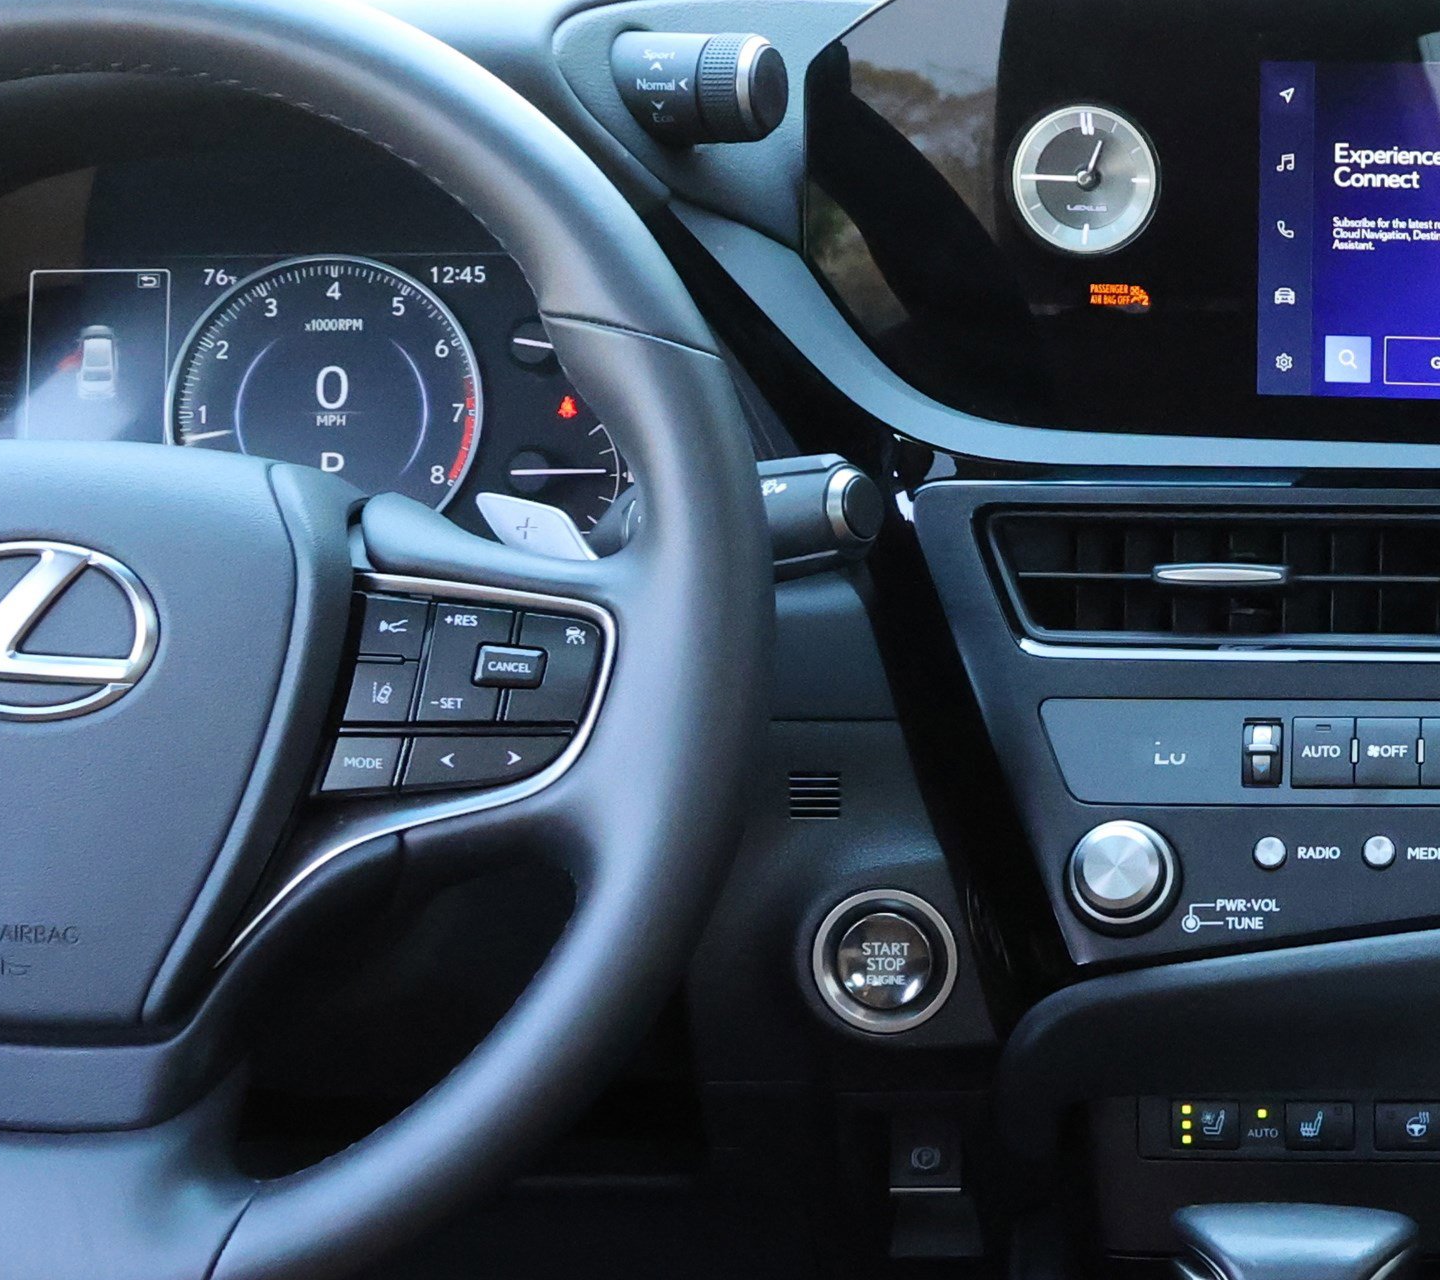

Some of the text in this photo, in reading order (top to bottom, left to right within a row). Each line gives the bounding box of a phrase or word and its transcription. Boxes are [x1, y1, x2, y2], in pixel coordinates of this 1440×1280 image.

[643, 49, 676, 61] Sport
[636, 78, 676, 91] Normal
[1333, 167, 1420, 189] Connect
[1066, 204, 1108, 213] LEXUS
[1332, 216, 1376, 228] Subscribe
[1376, 217, 1391, 228] for
[1391, 217, 1407, 229] the
[1408, 218, 1433, 230] latest
[1332, 227, 1361, 239] Cloud
[1361, 228, 1412, 242] Navigation,
[1332, 239, 1376, 251] Assistant.
[430, 265, 486, 283] 12:45
[326, 282, 341, 300] 4
[1089, 283, 1129, 294] PASSENGER
[392, 297, 405, 316] 5
[1089, 294, 1131, 305] AIR BAG OFF
[265, 299, 278, 317] 3
[216, 340, 229, 360] 2
[435, 339, 449, 358] 6
[316, 366, 348, 409] 0
[198, 405, 207, 424] 1
[316, 415, 346, 426] MPH
[452, 404, 464, 423] 7
[321, 452, 345, 472] D
[430, 466, 445, 484] 8
[488, 660, 532, 674] CANCEL
[1301, 745, 1341, 758] AUTO
[1380, 745, 1408, 758] OFF
[343, 756, 383, 770] MODE
[1297, 846, 1341, 859] RADIO
[1226, 917, 1264, 930] TUNE
[861, 942, 910, 956] START
[866, 958, 906, 971] STOP
[866, 975, 906, 986] ENGINE
[1247, 1128, 1279, 1138] AUTO
